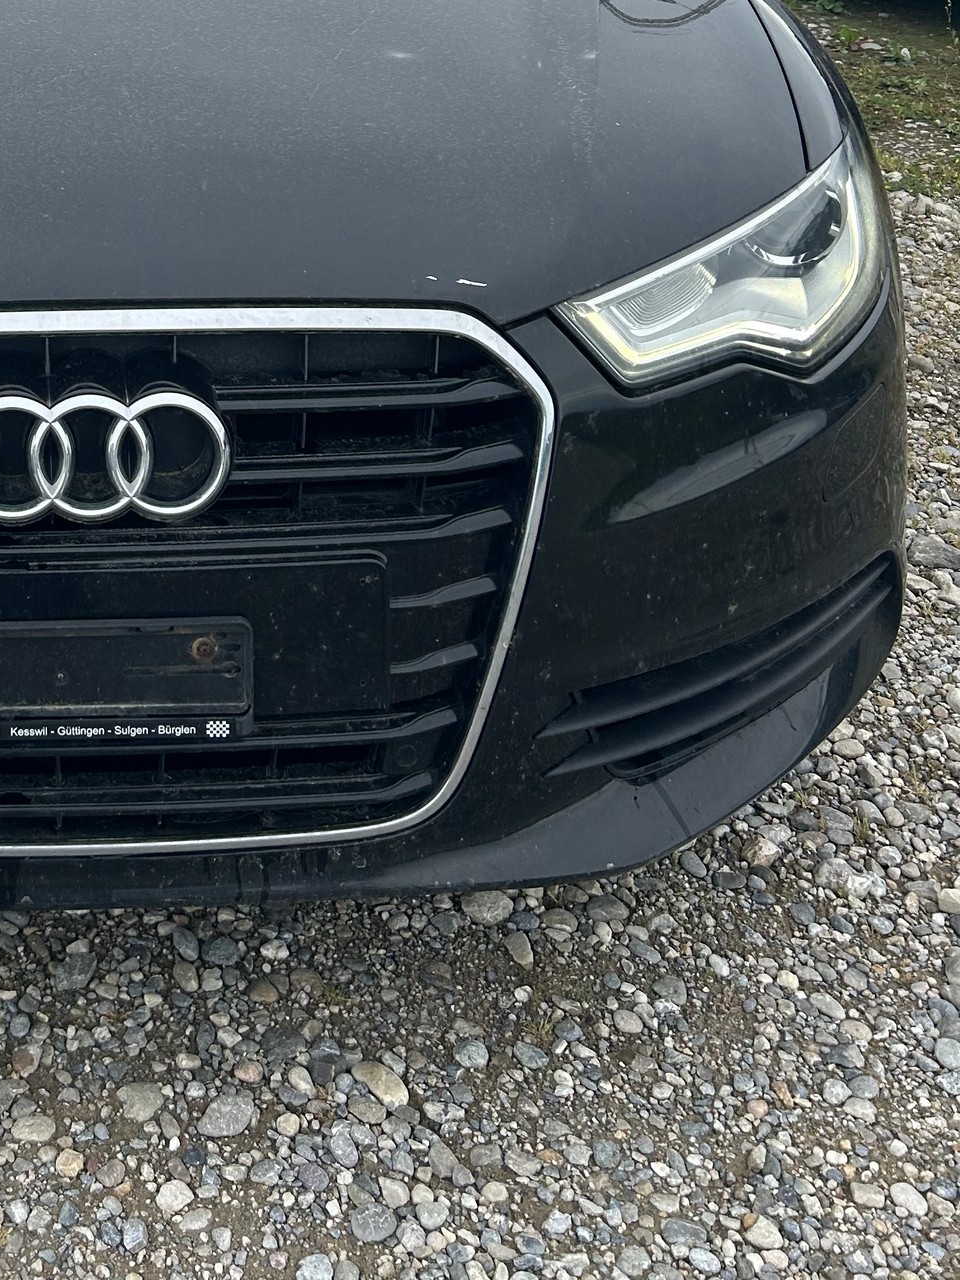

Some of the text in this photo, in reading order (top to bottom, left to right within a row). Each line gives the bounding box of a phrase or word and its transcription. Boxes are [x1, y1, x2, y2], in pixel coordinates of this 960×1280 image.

[10, 726, 48, 737] Kesswil
[57, 725, 105, 738] Güttingen
[114, 724, 149, 737] Sulgen
[158, 724, 197, 736] Bürglen
